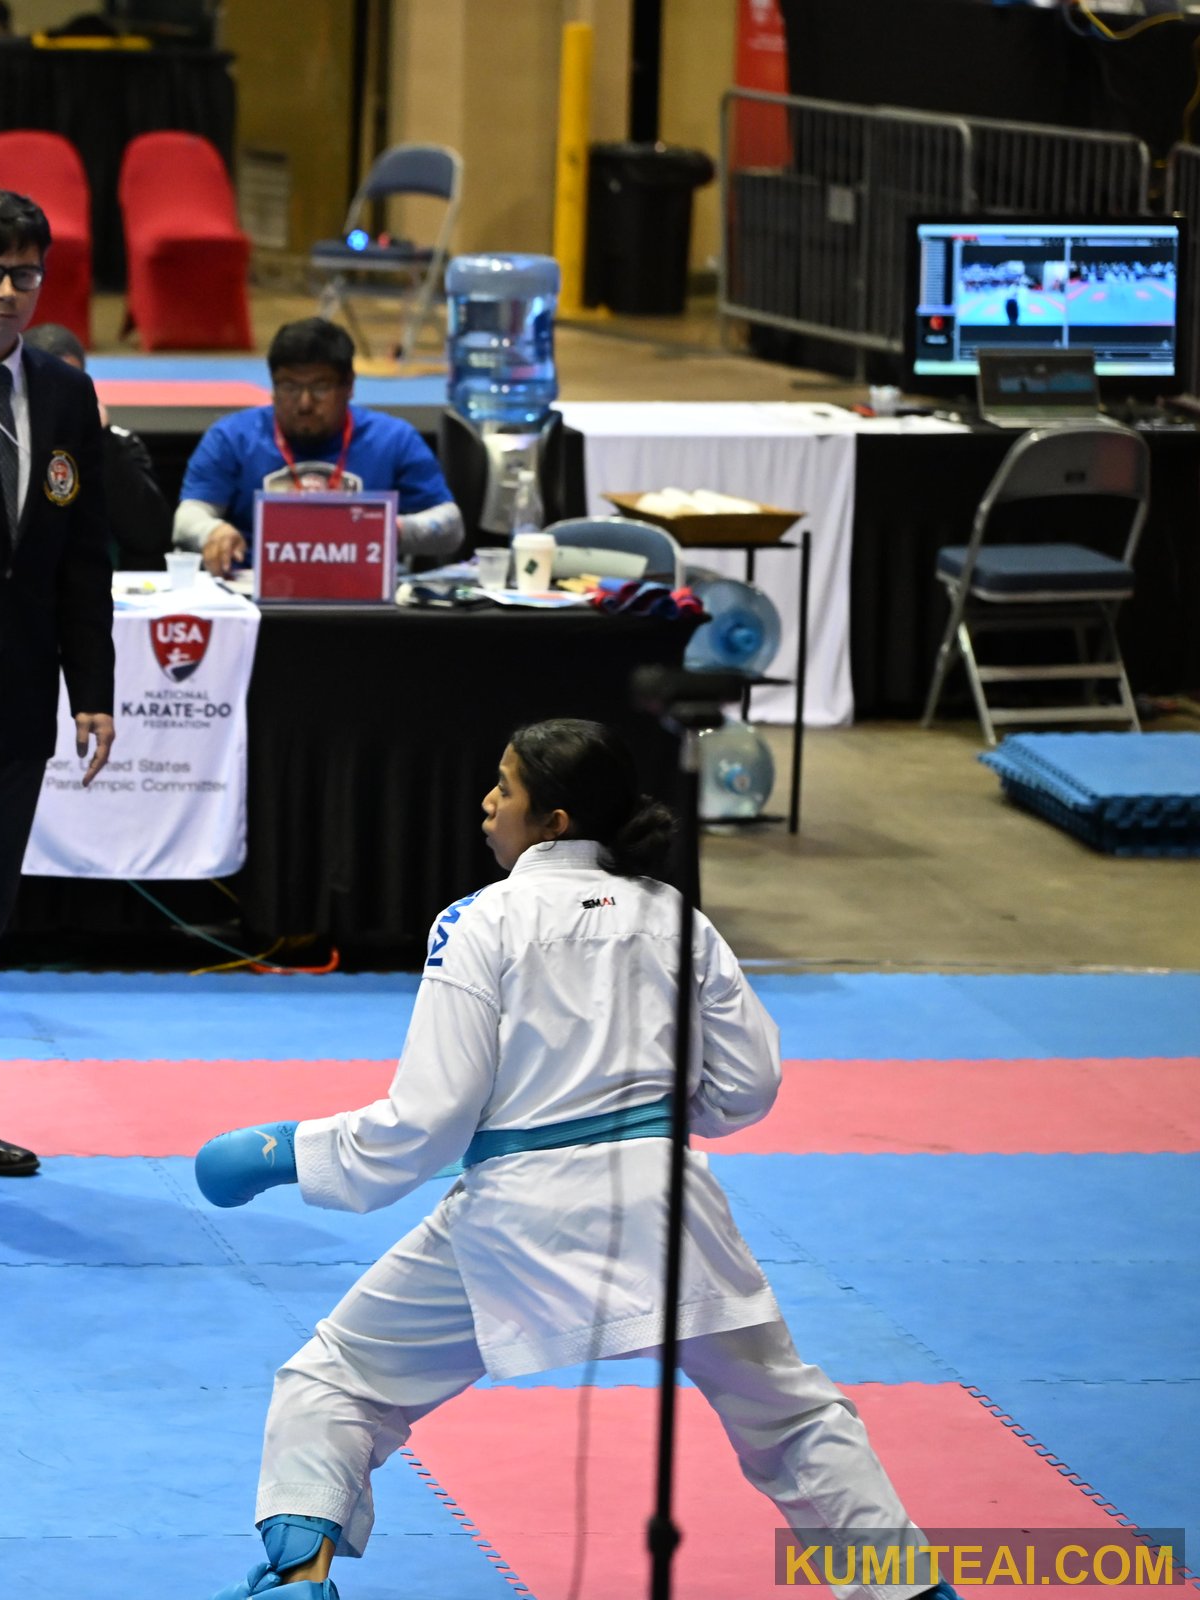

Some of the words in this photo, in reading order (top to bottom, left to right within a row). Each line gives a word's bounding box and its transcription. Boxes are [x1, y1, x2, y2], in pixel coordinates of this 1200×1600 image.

[265, 541, 357, 563] TATAMI
[366, 542, 382, 564] 2
[157, 621, 203, 643] USA
[144, 690, 209, 700] NATIONAL
[121, 703, 232, 718] KARATE-DO
[143, 720, 211, 729] FEDERATION
[138, 758, 191, 773] States
